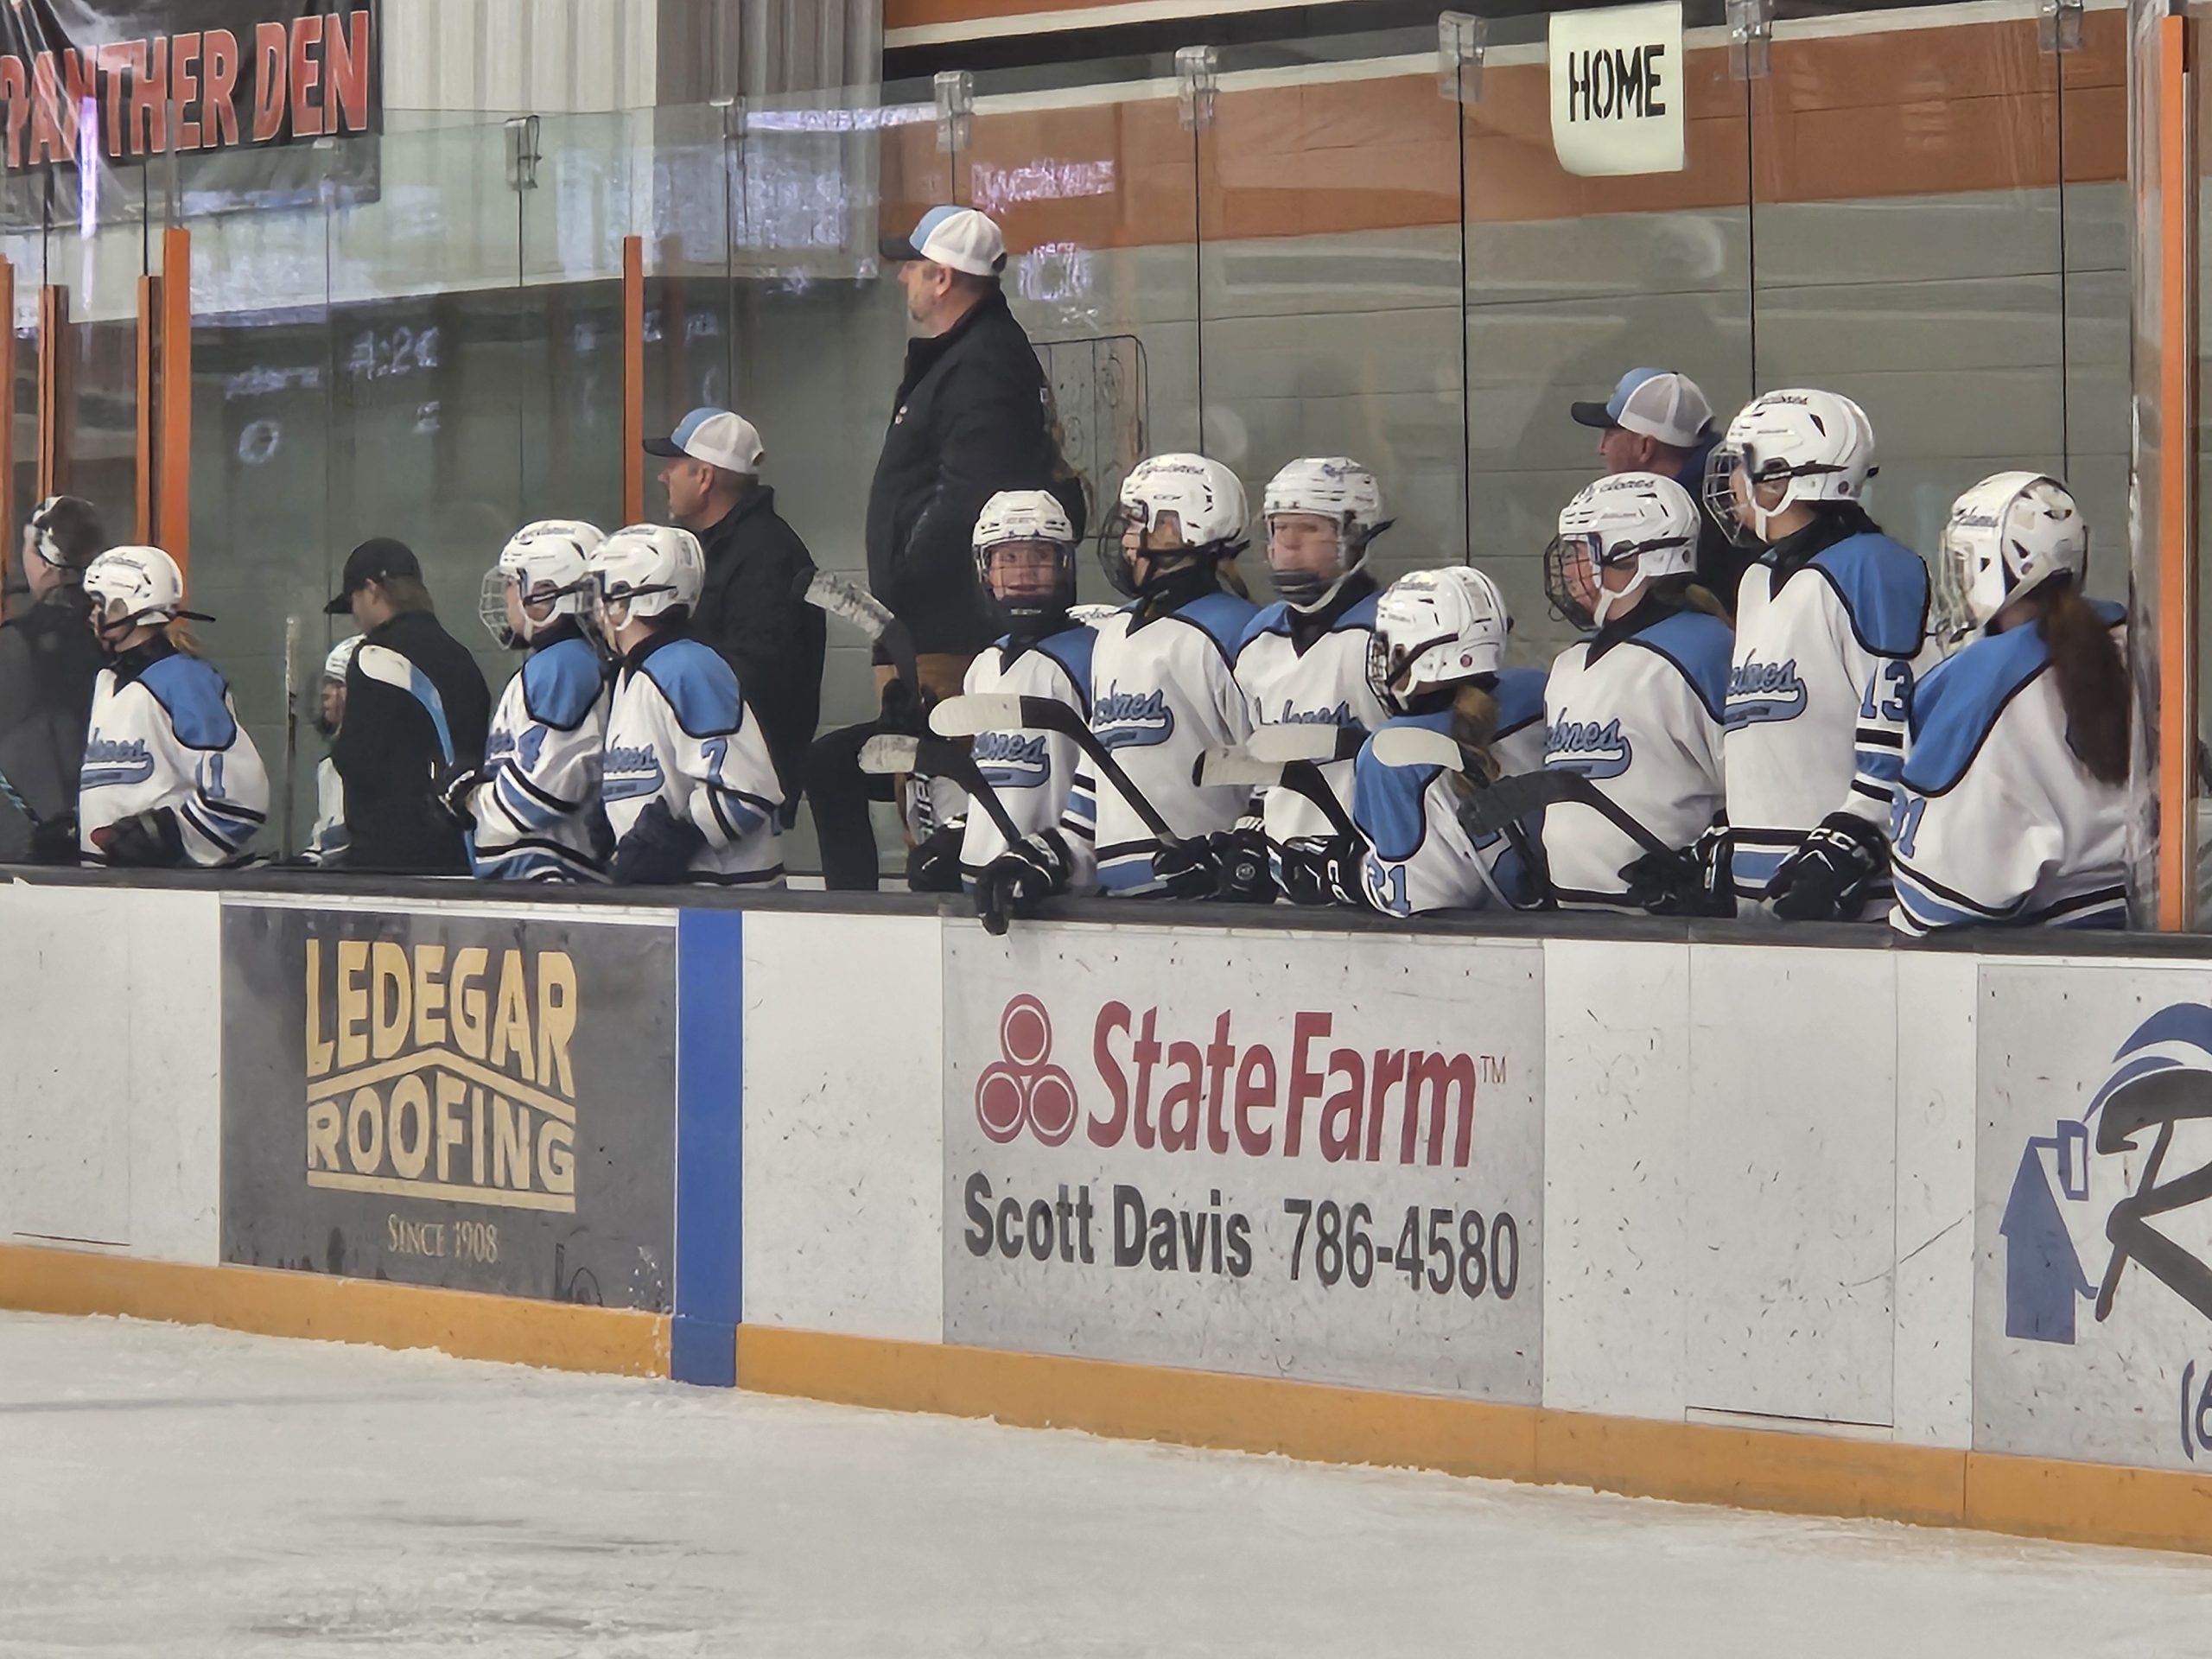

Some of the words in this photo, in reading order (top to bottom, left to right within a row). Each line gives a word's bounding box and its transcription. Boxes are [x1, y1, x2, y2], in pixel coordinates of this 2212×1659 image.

[0, 29, 238, 168] PANTHER
[252, 10, 370, 143] DEN
[1569, 44, 1666, 122] HOME
[306, 938, 577, 1099] LEDEGAR
[307, 1069, 575, 1194] ROOFING
[388, 1213, 446, 1258] SINCE
[453, 1221, 499, 1264] 1908
[964, 1172, 1095, 1264] Scott
[1113, 1184, 1253, 1278] Davis
[1284, 1198, 1520, 1300] 786-4580
